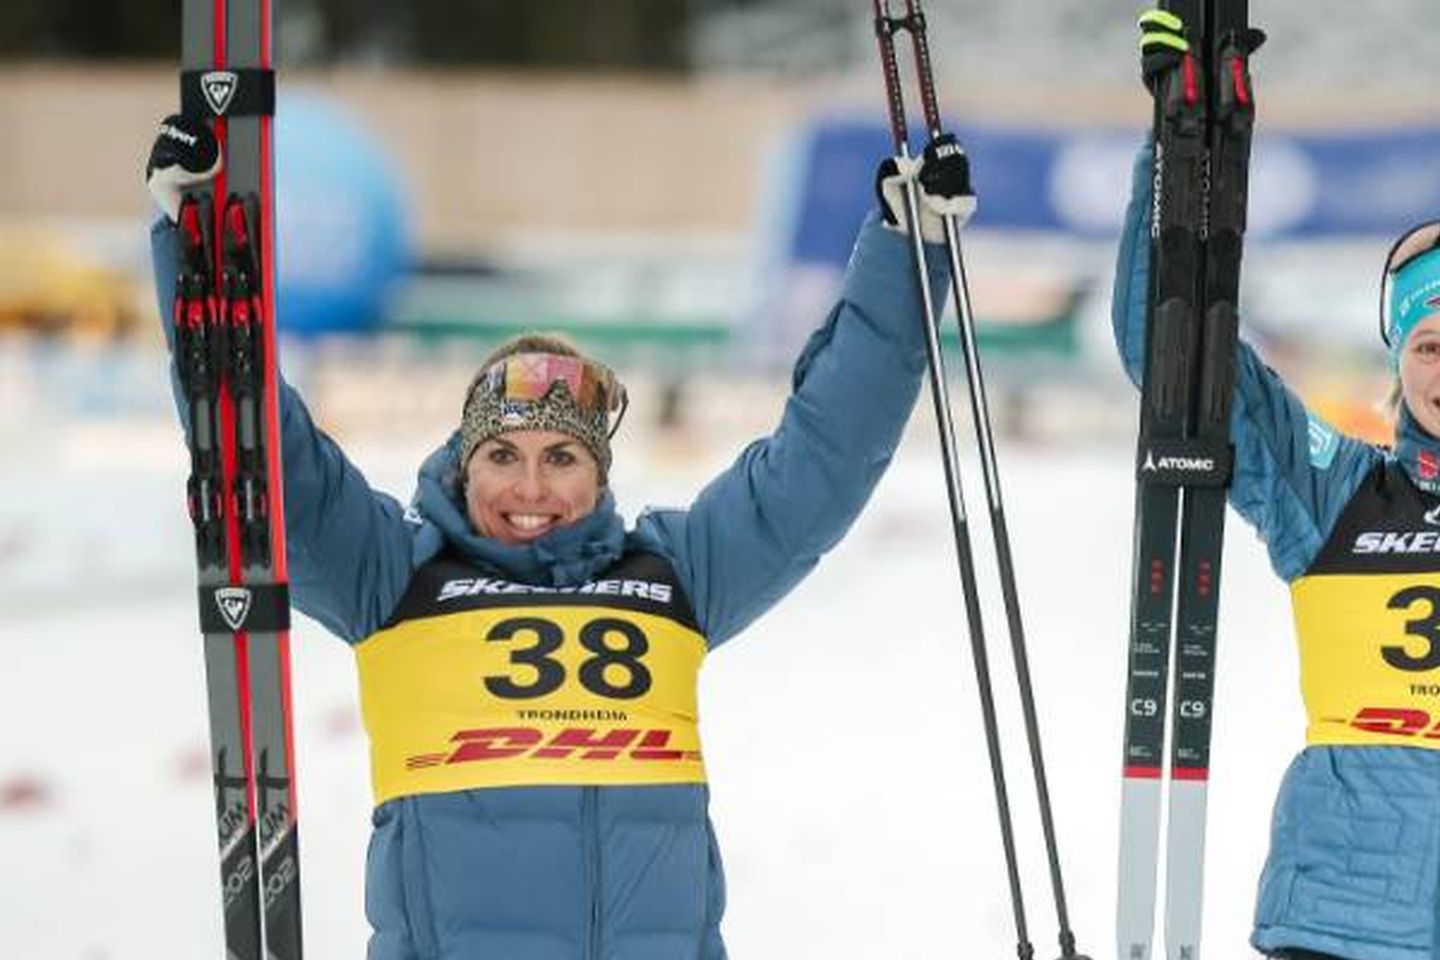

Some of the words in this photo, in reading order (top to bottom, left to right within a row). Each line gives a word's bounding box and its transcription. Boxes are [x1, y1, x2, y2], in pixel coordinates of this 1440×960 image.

[1151, 140, 1163, 240] ATOMIC
[1157, 456, 1215, 471] ATOMIC
[436, 577, 674, 603] SKEERS
[484, 617, 653, 700] 38
[1131, 698, 1158, 717] C9
[1180, 700, 1206, 719] C9
[445, 727, 684, 764] DHL
